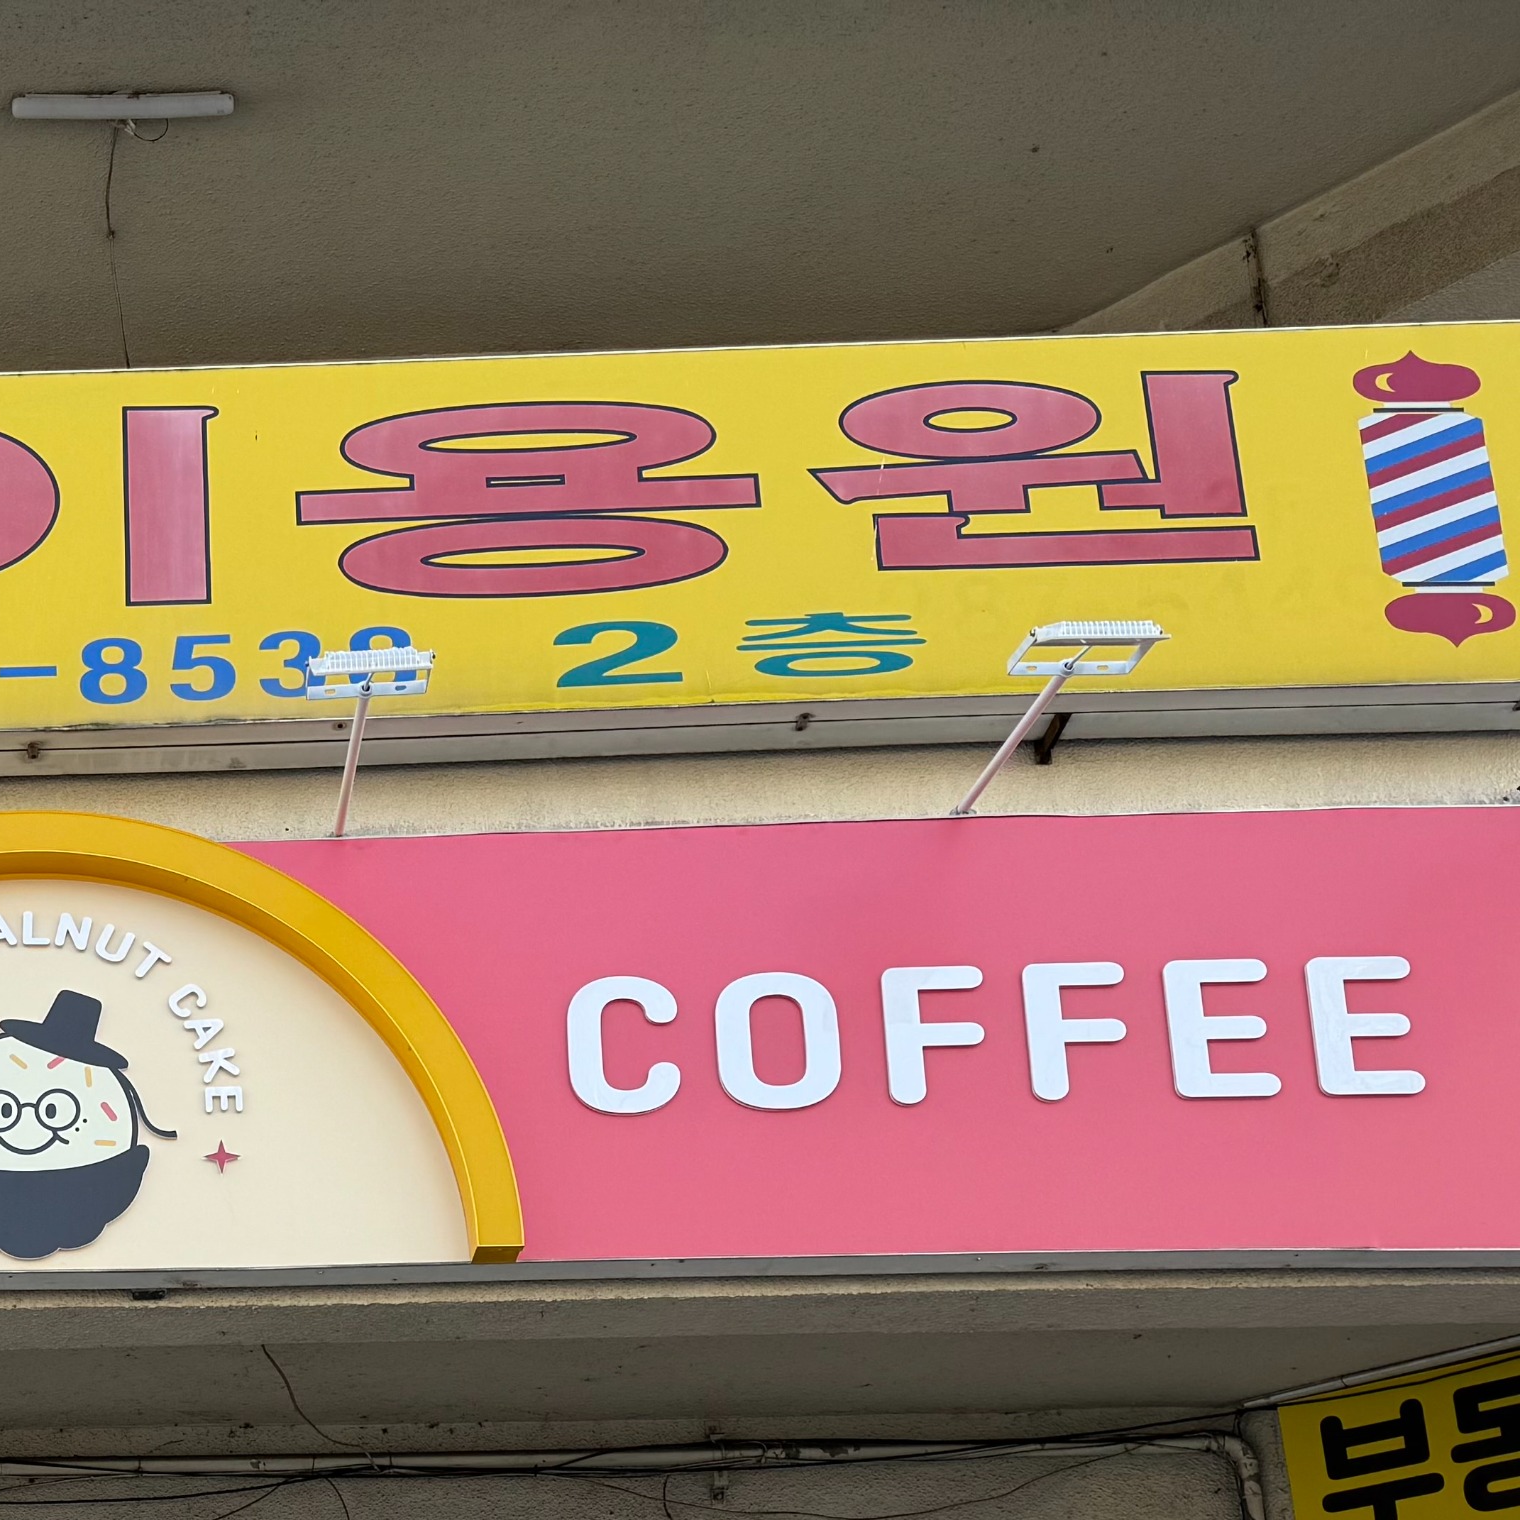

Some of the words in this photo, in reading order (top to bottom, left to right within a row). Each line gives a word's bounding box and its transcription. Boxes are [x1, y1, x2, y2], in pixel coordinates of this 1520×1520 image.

[553, 611, 927, 689] 2층
[167, 983, 244, 1114] CAKE
[566, 955, 1427, 1116] COFFEE
